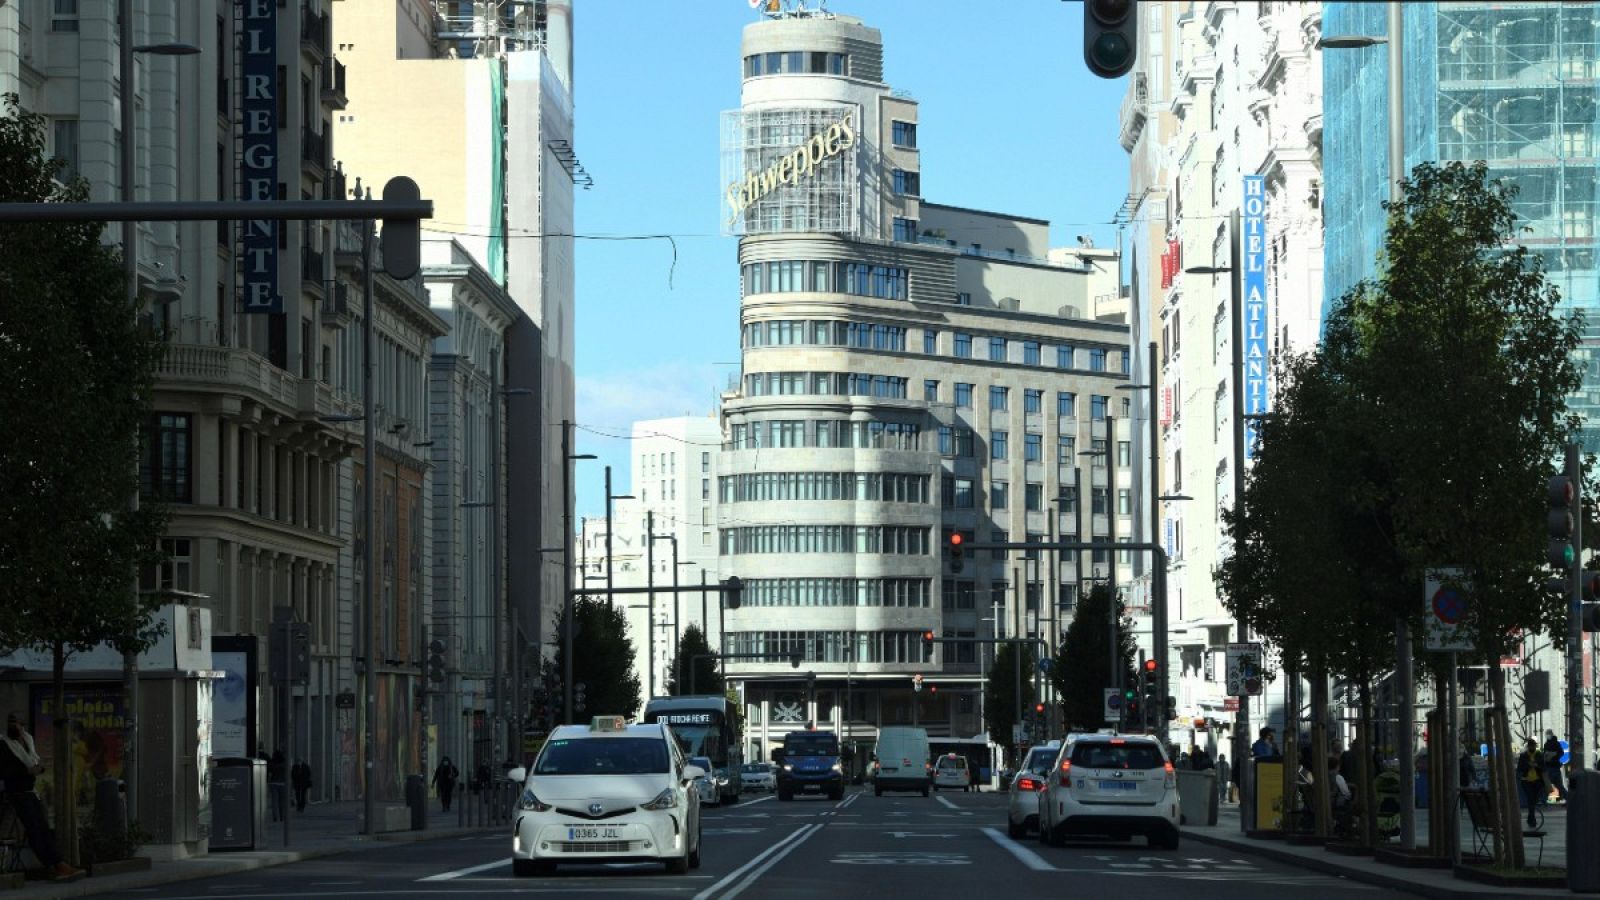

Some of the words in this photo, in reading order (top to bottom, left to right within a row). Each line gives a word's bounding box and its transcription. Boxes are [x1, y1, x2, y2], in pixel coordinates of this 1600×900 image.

[245, 74, 274, 307] REGENTE
[725, 112, 855, 226] Schweppes
[1246, 179, 1263, 272] HOTEL
[1247, 285, 1264, 455] ATLANTI
[41, 697, 114, 714] Eplota
[575, 828, 598, 839] 0365
[602, 828, 619, 838] JZL
